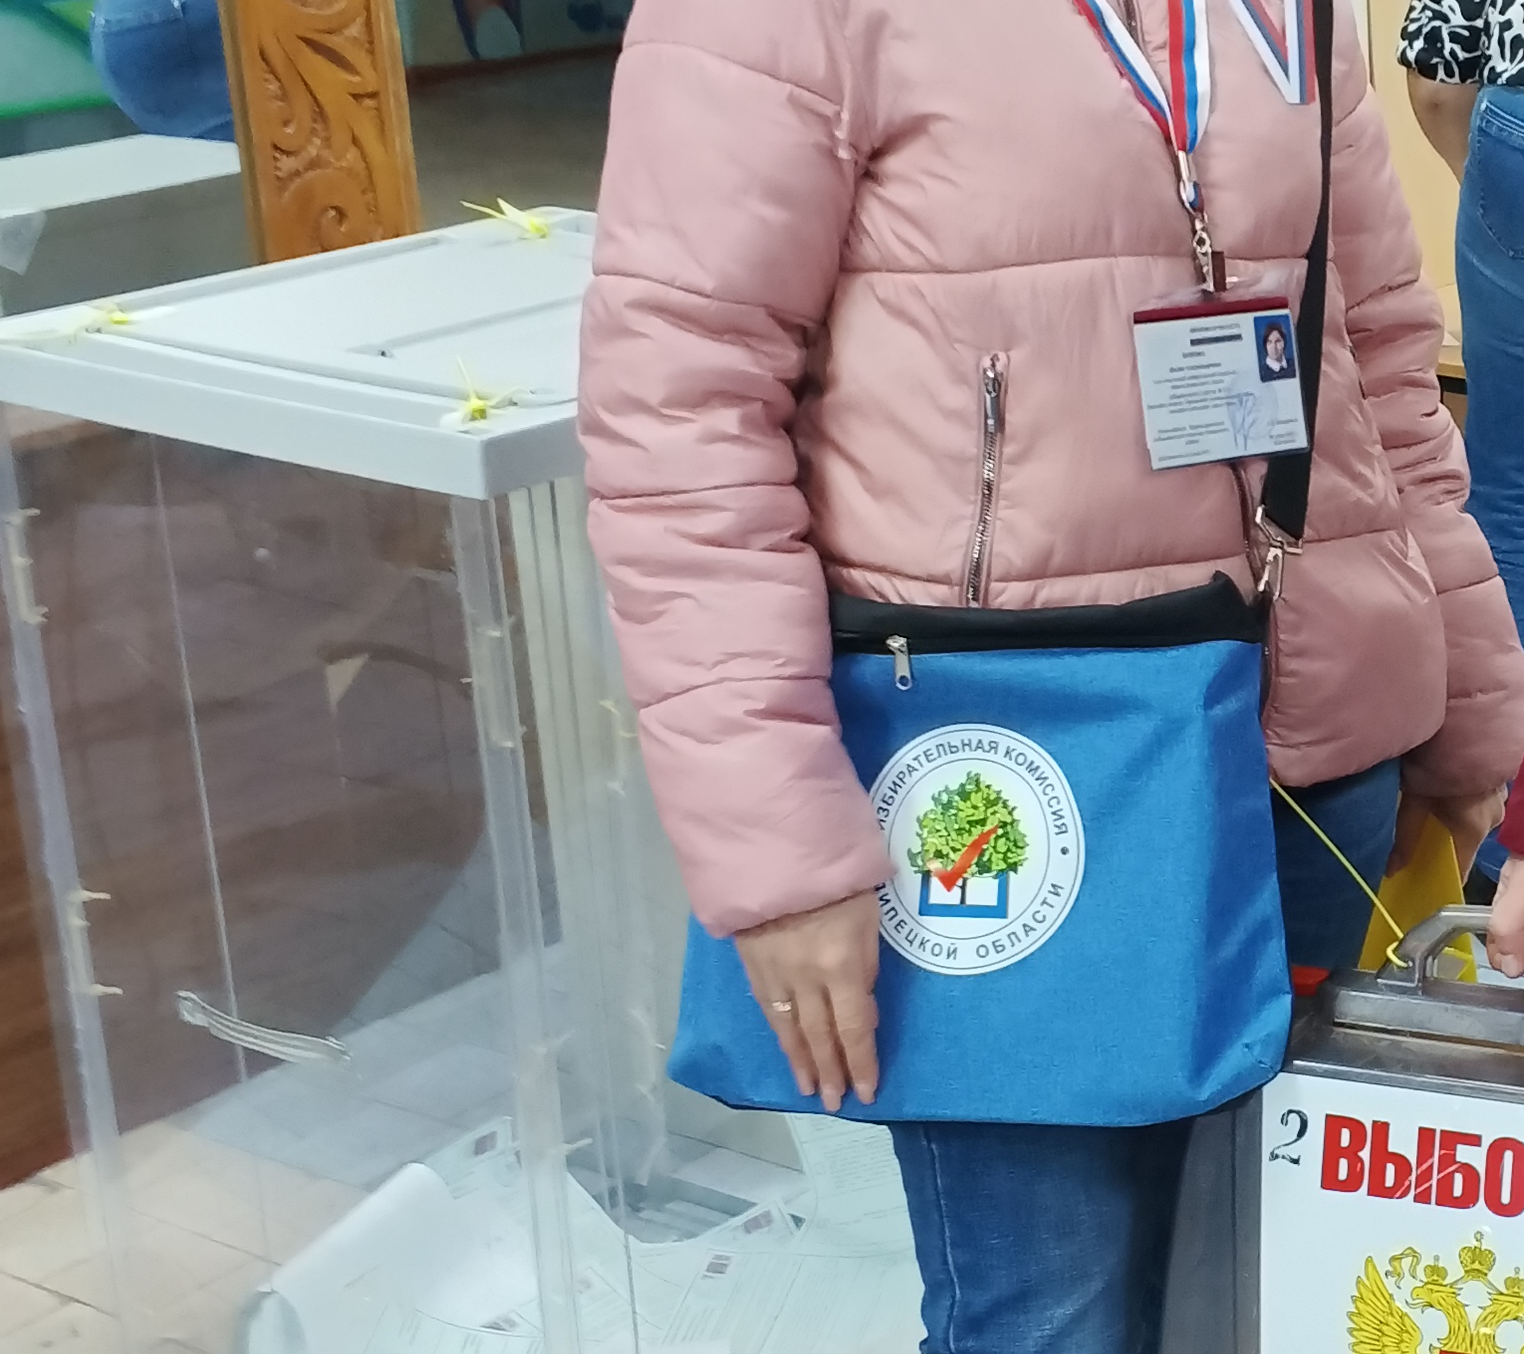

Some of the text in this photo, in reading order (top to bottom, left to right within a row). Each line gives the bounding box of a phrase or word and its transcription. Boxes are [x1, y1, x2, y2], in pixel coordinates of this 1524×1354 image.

[1003, 744, 1070, 837] КОМИССИЯ
[975, 882, 1066, 960] ОБЛАСТИ
[1268, 1108, 1310, 1166] 2
